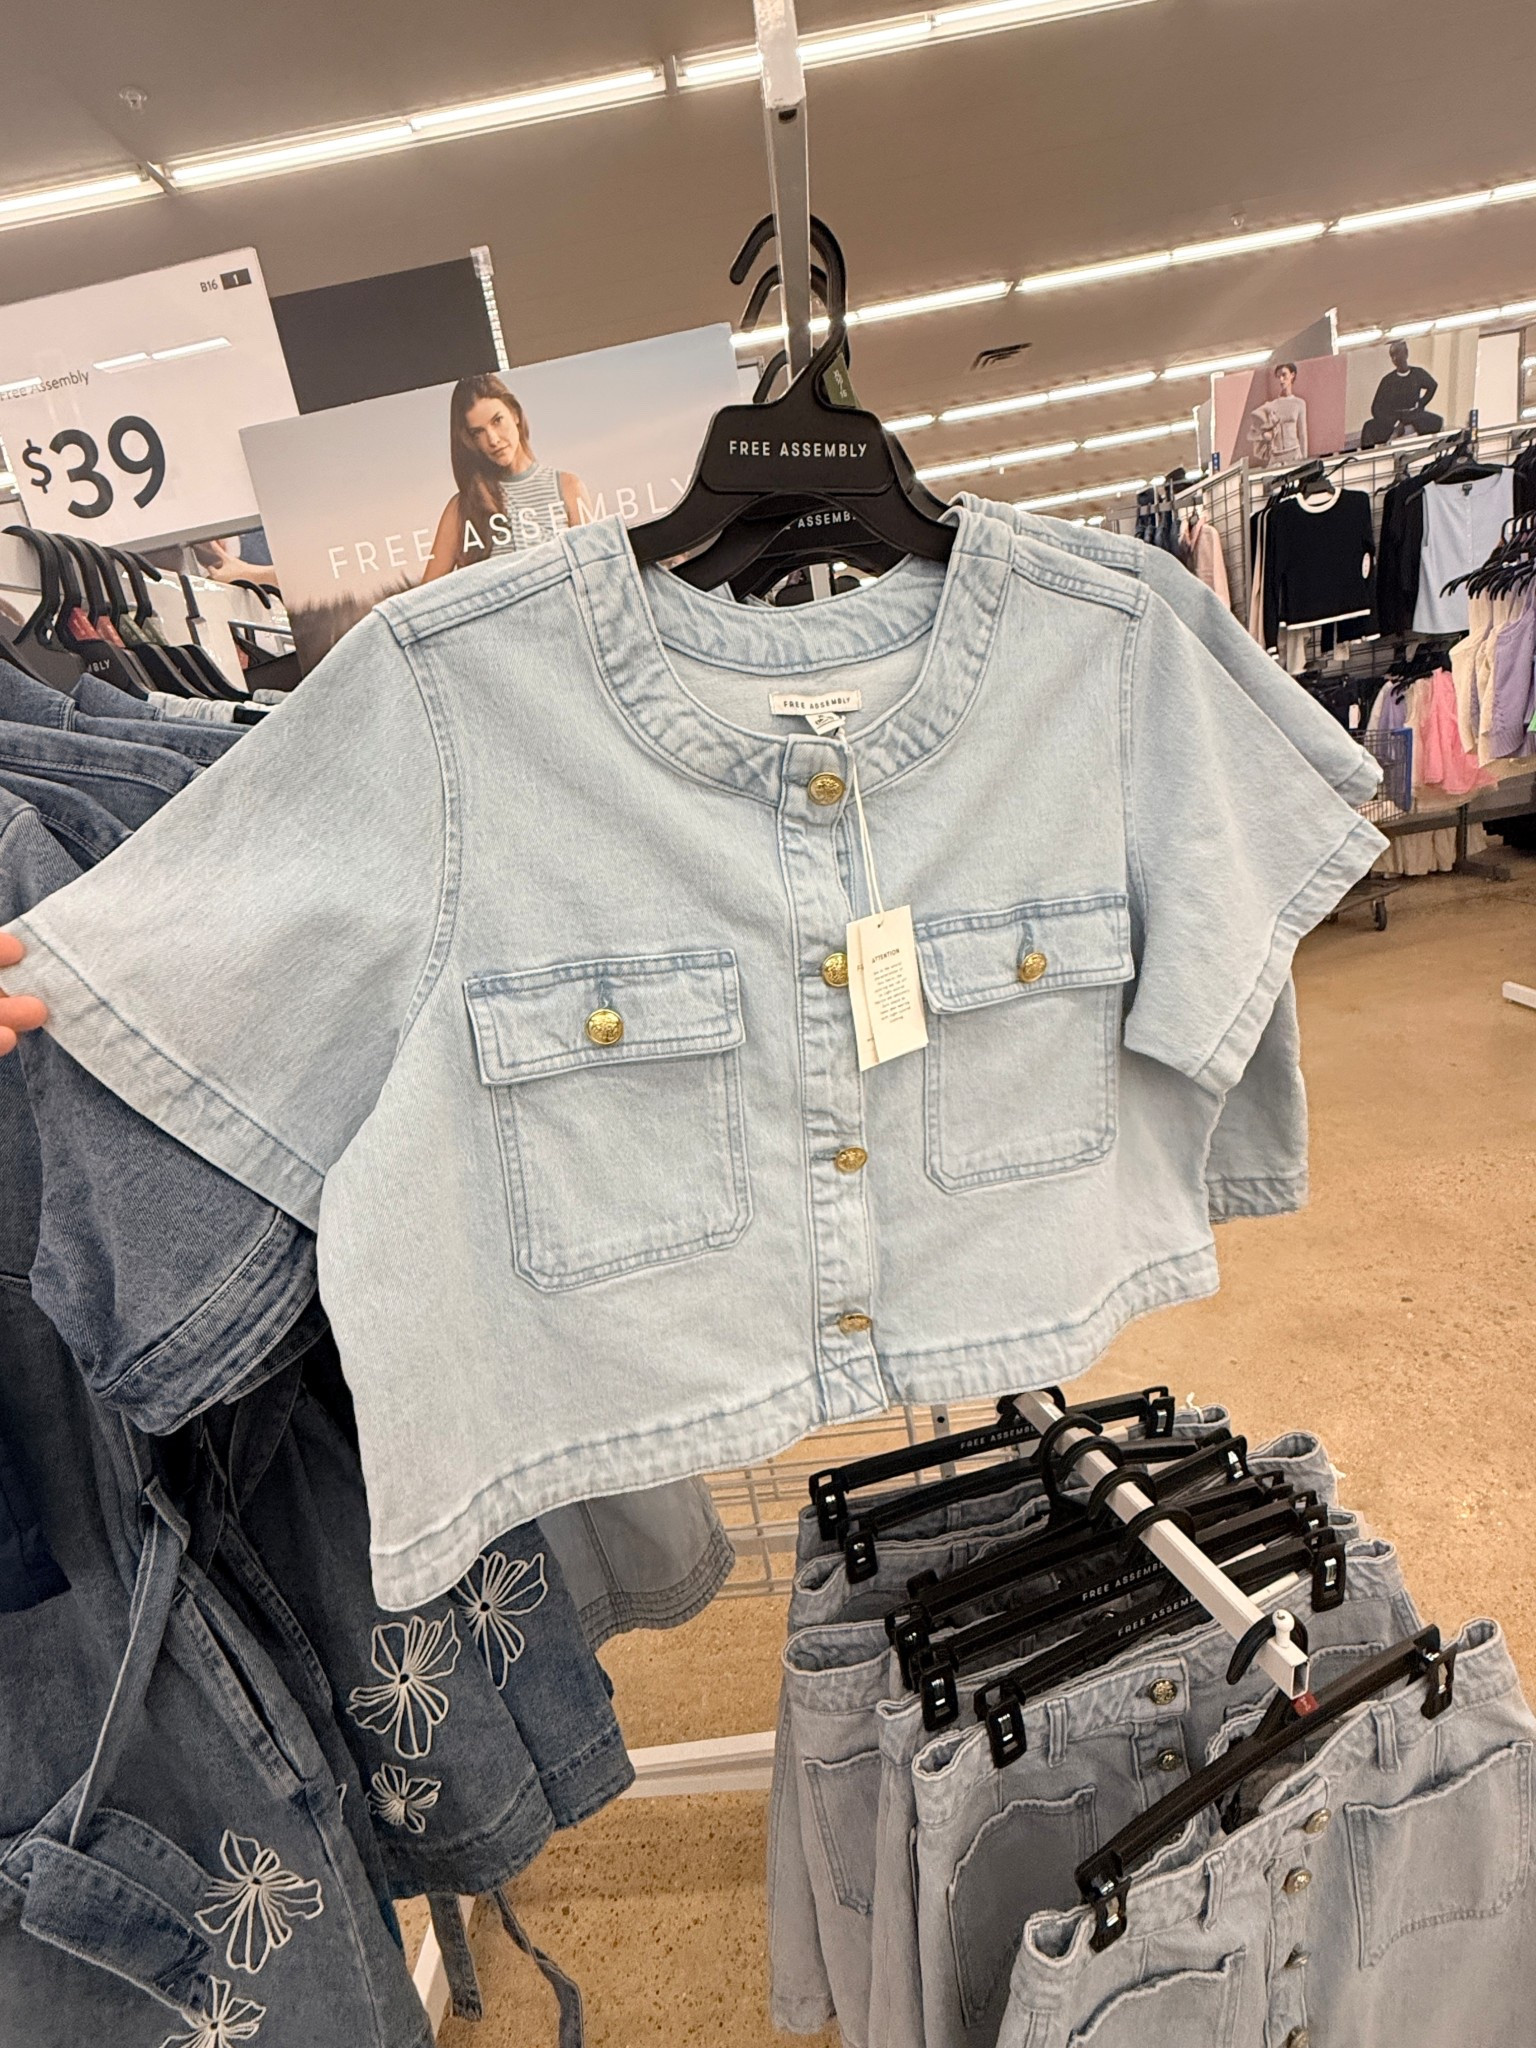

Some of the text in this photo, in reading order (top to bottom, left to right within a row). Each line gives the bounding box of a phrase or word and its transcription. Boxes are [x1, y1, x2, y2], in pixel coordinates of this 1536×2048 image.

[200, 278, 218, 292] B16
[31, 369, 89, 394] Assembly
[729, 440, 867, 458] FREE ASSEMBLY
[22, 415, 166, 519] $39
[797, 510, 857, 529] ASSEMB
[328, 528, 435, 579] FREE
[783, 697, 851, 710] FREE ASSEMBLY
[872, 948, 900, 964] ATTENTION
[960, 1425, 1036, 1450] FREE ASSEMBL
[1082, 1562, 1165, 1601] FREE ASSEMBL
[1118, 1617, 1146, 1637] FREE
